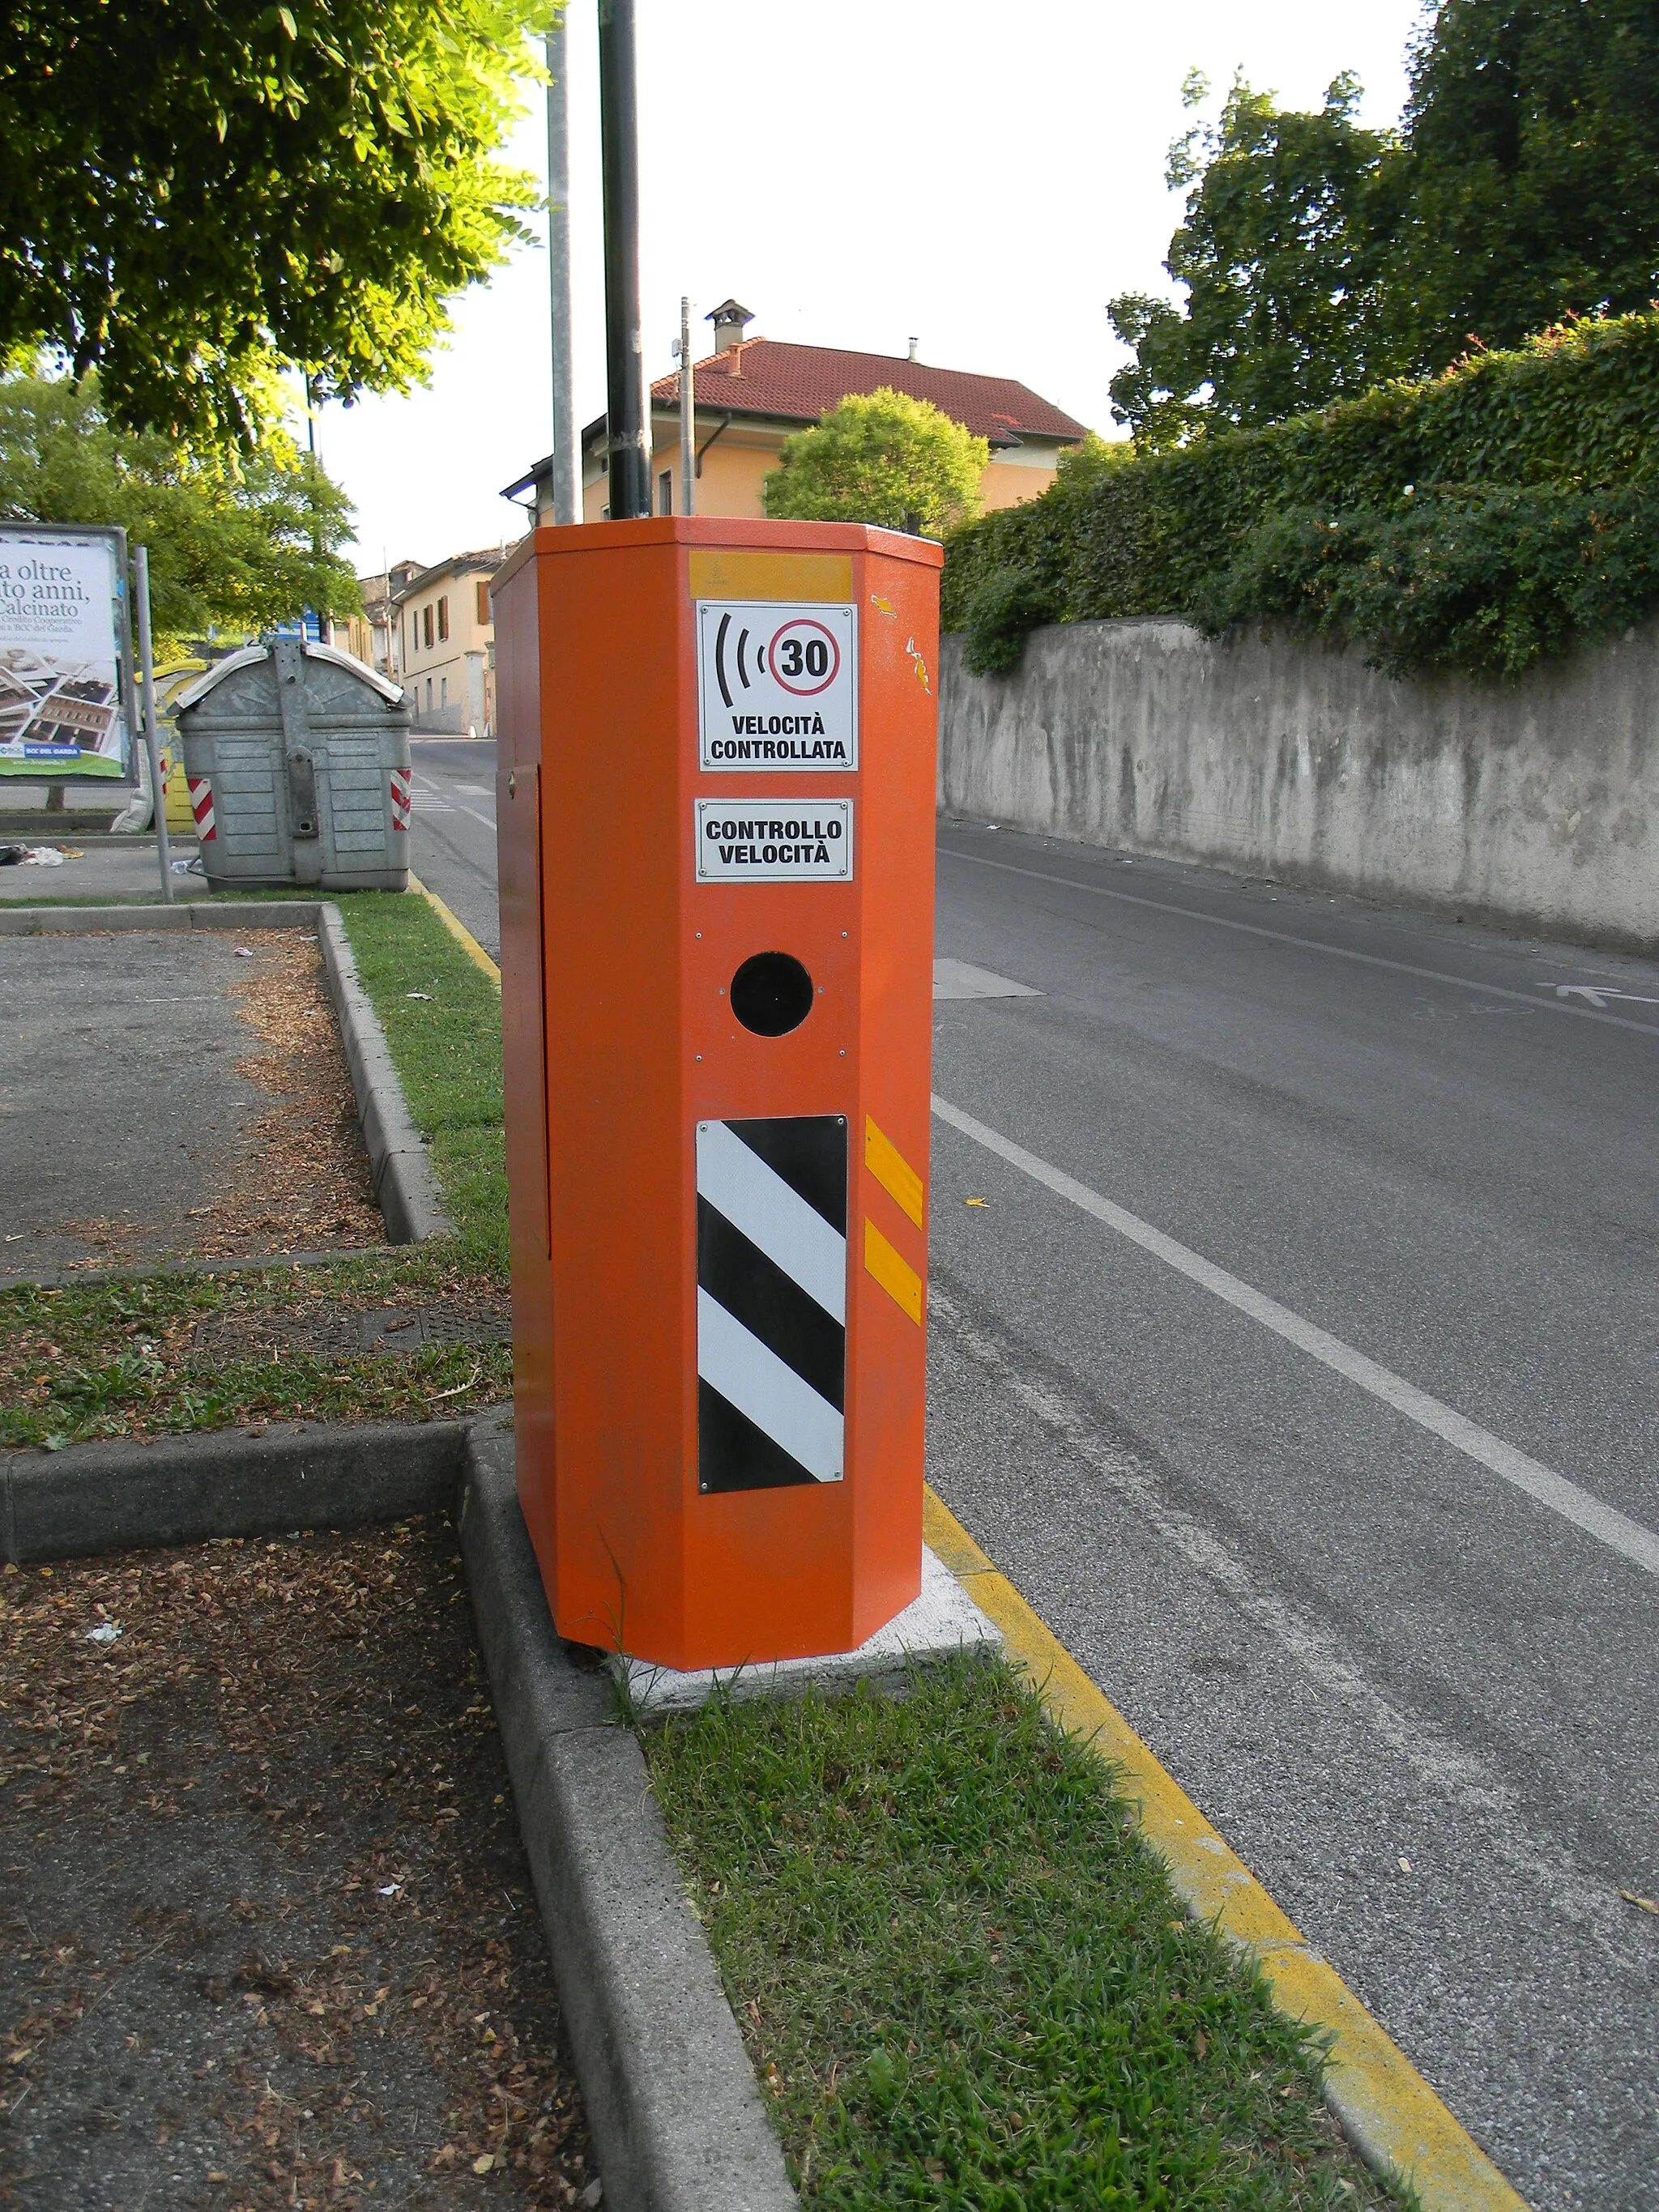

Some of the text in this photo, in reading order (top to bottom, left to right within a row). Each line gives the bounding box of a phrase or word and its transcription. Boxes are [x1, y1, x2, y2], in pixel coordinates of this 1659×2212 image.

[18, 559, 72, 582] oltre
[0, 581, 90, 604] to anni,
[781, 639, 829, 677] 30
[732, 711, 825, 735] VELOCITÀ
[711, 740, 847, 759] CONTROLLATA
[706, 820, 842, 840] CONTROLLO
[719, 840, 830, 863] VELOCITÀ
